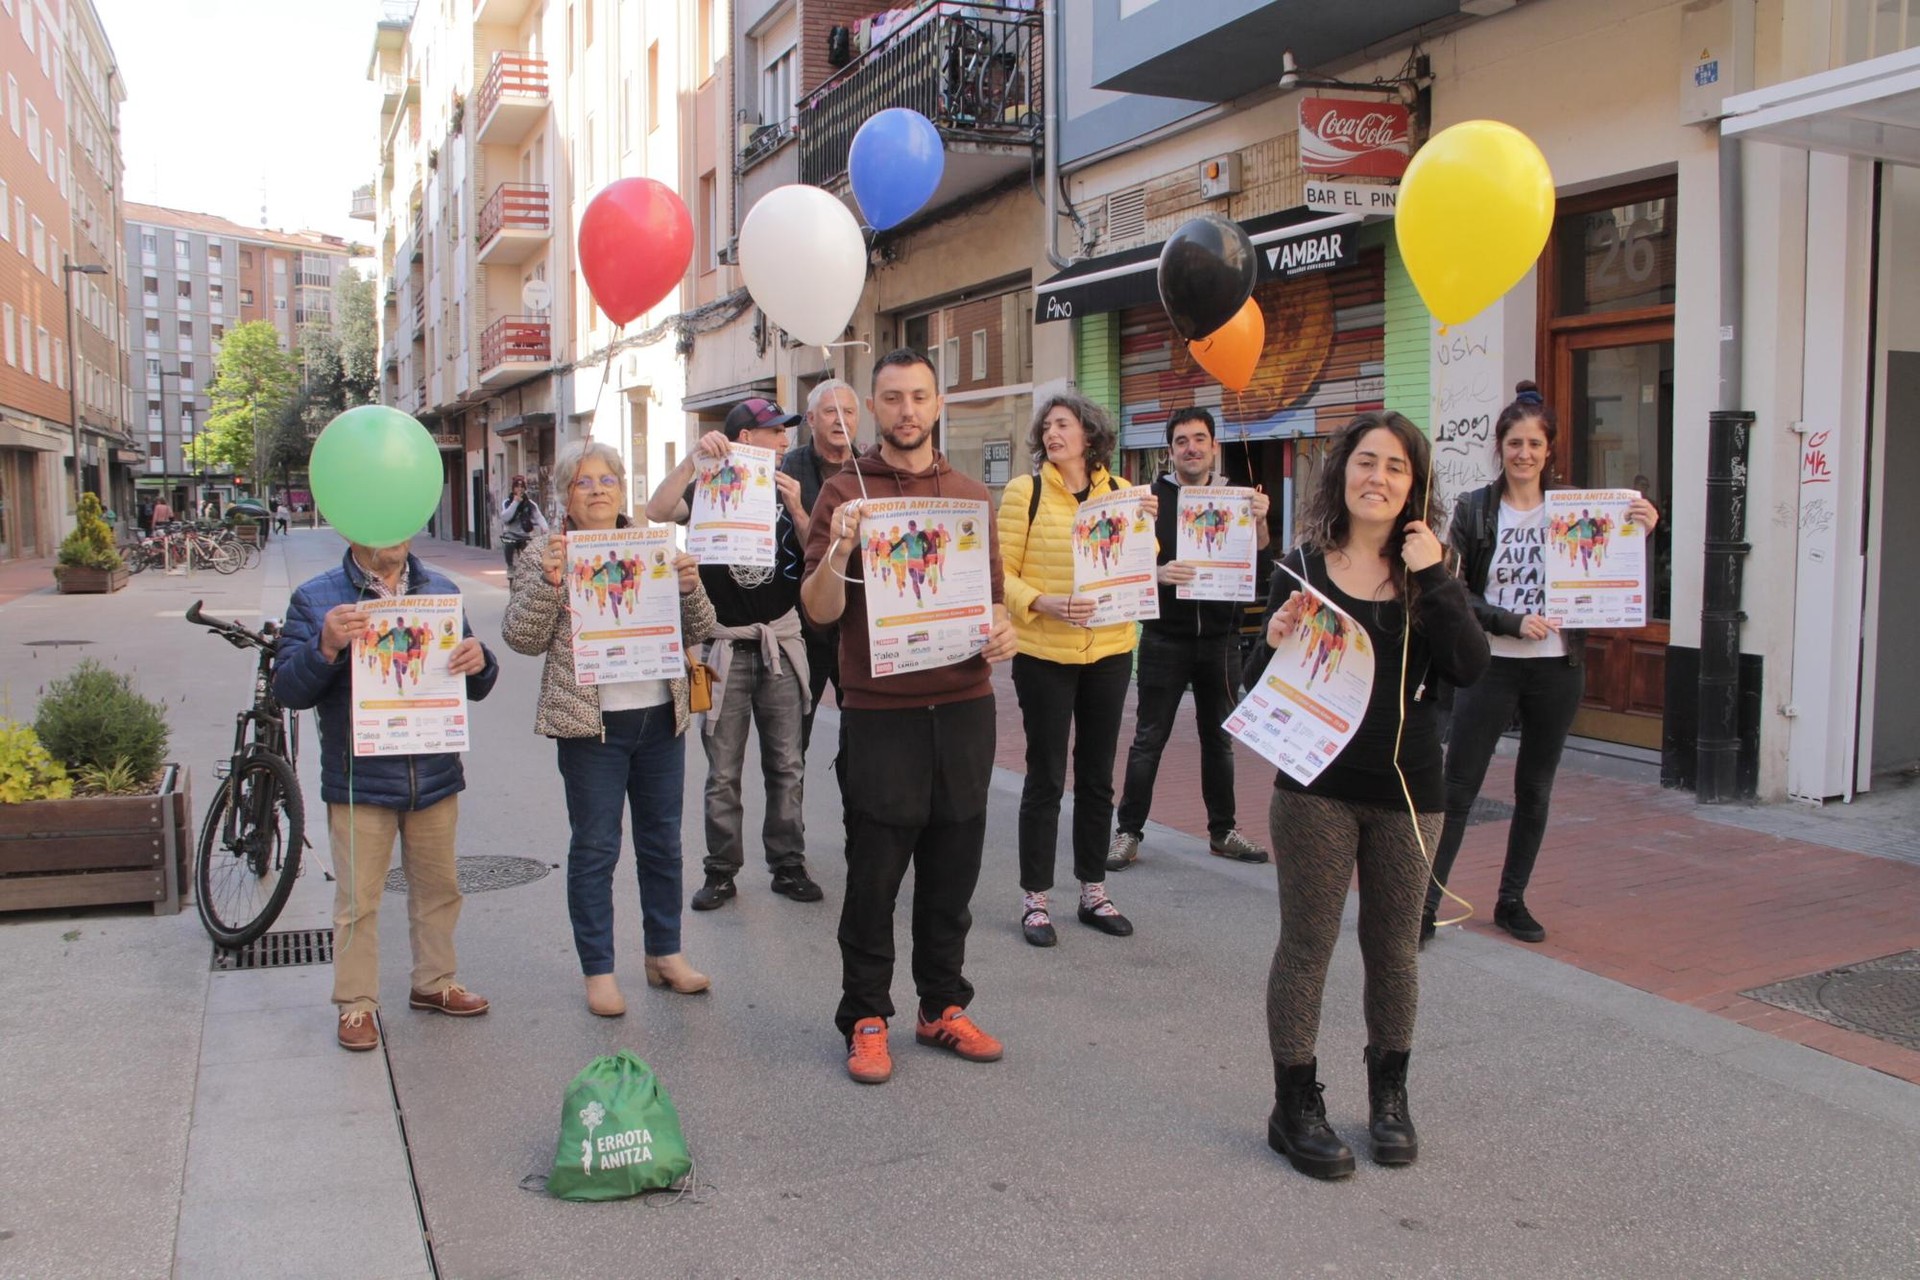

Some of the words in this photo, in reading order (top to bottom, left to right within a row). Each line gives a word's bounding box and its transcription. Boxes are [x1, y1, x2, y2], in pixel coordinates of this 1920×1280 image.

[1318, 110, 1397, 147] Coca-Cola
[1307, 188, 1336, 205] BAR
[1344, 191, 1362, 206] EL
[1280, 233, 1343, 270] AMBAR
[1591, 218, 1655, 287] 26
[985, 445, 991, 460] SE
[992, 444, 1009, 460] VENDE
[910, 500, 949, 510] ANITZA
[952, 501, 981, 509] 2025
[1551, 493, 1582, 501] ERROTA
[1584, 492, 1614, 500] ANITZA
[573, 533, 608, 543] ERROTA
[610, 530, 644, 541] ANITZA
[646, 529, 669, 539] 2025
[400, 599, 434, 607] ANITZA
[437, 598, 458, 606] 2025
[597, 1129, 653, 1152] ERROTA
[600, 1146, 653, 1170] ANITZA
